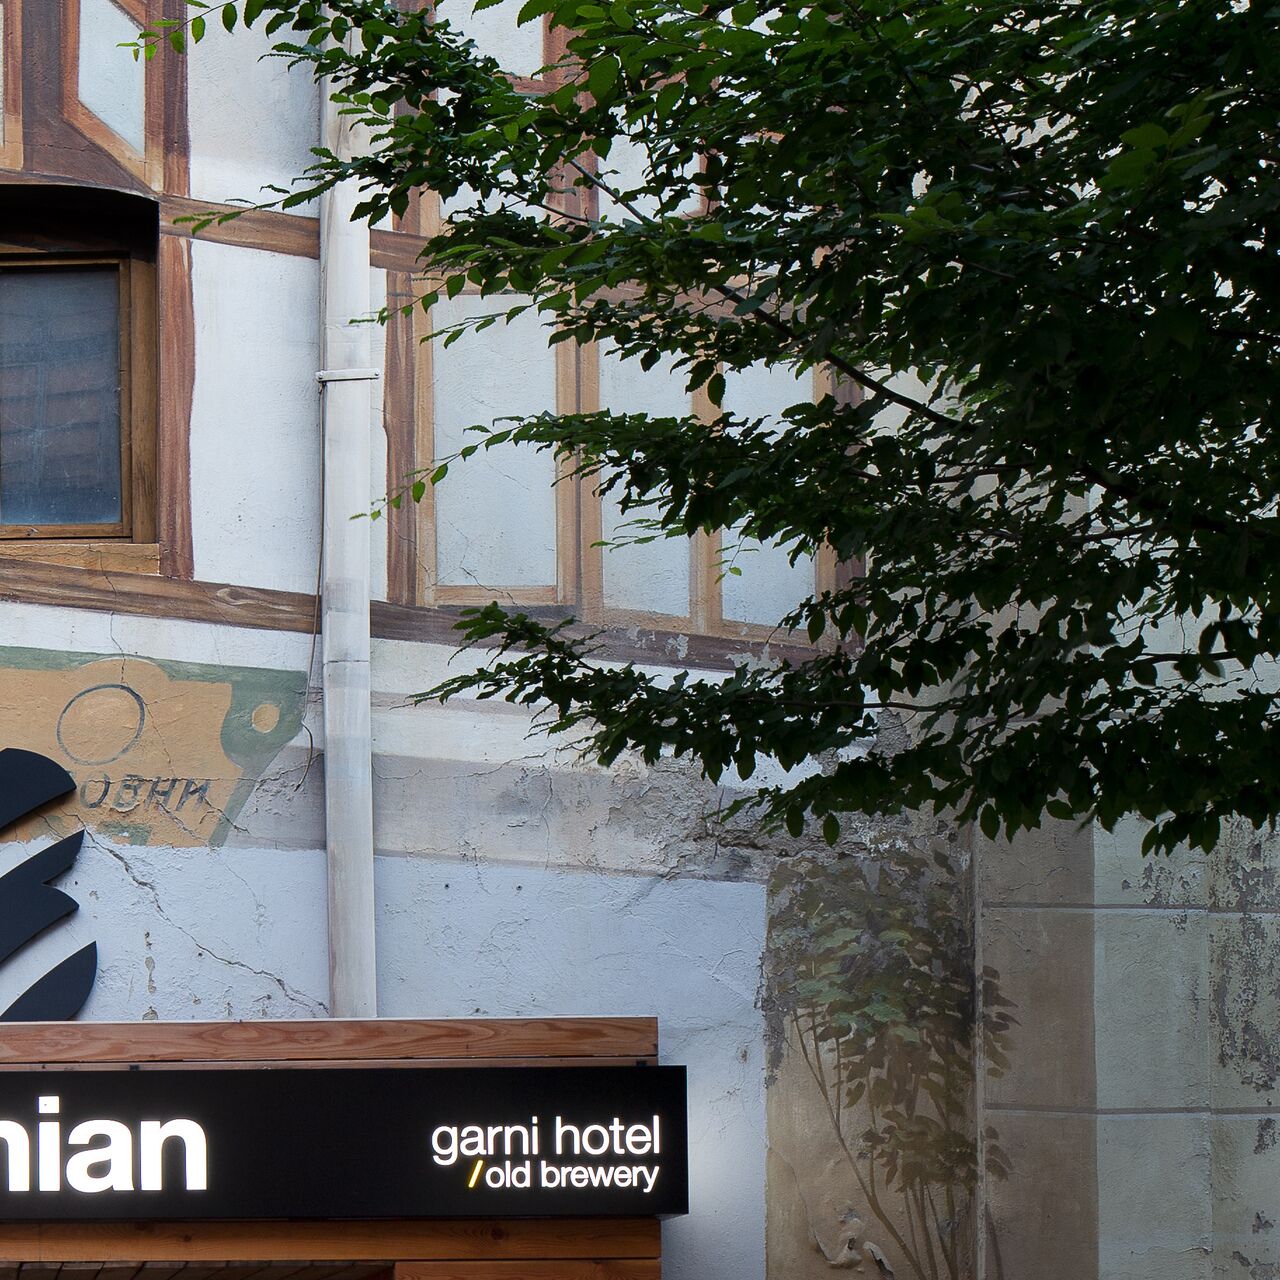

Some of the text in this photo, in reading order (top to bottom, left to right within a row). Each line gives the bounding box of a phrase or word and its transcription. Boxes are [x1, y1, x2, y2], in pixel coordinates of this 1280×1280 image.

[432, 1115, 660, 1165] garni hotel
[541, 1160, 659, 1193] brewery
